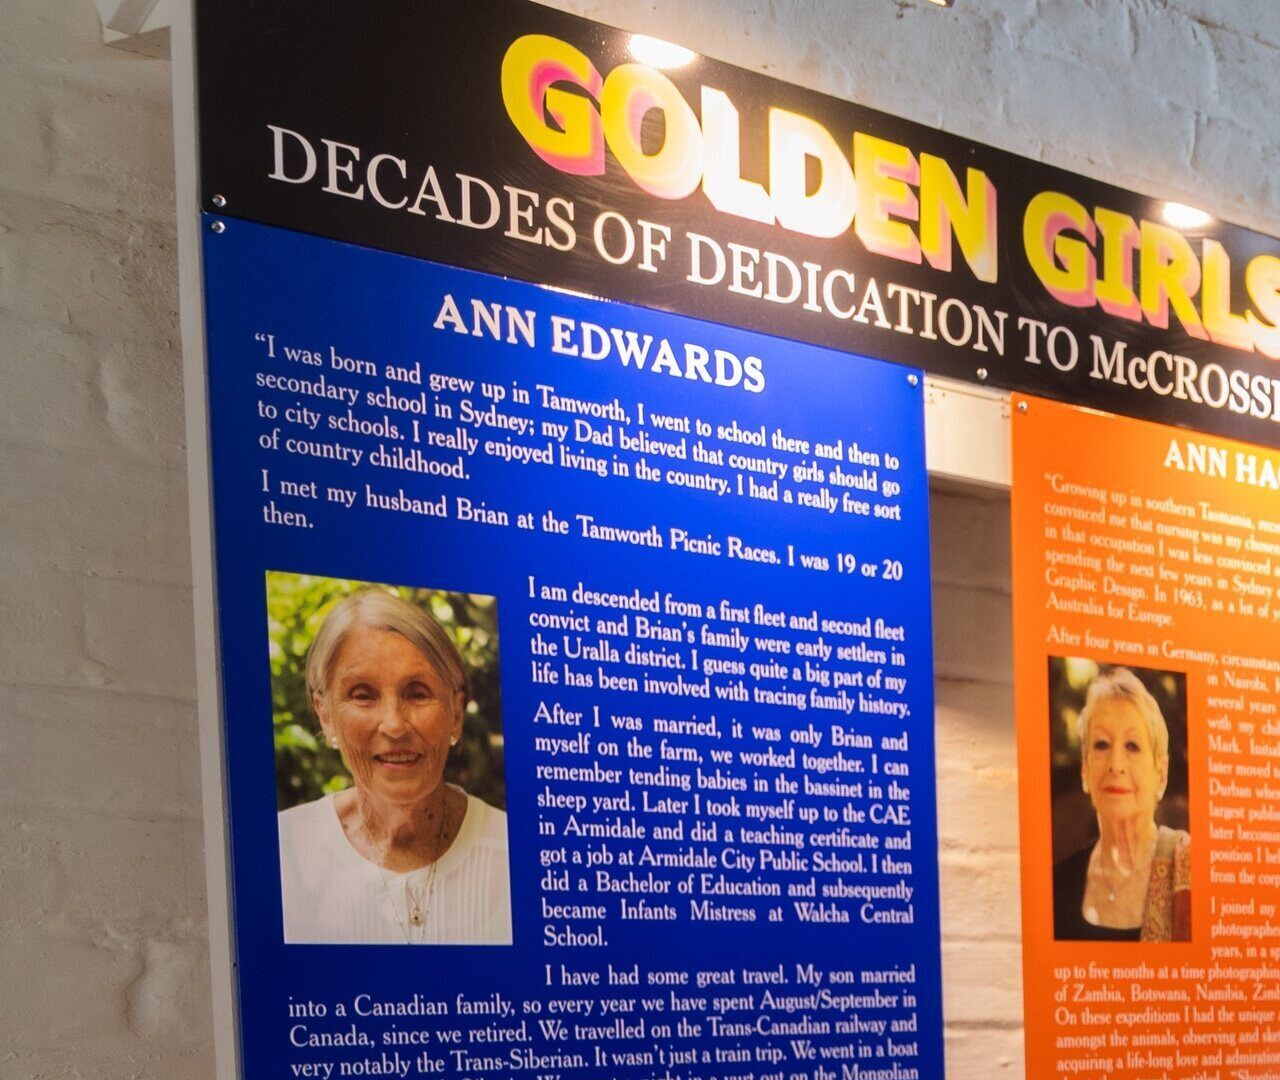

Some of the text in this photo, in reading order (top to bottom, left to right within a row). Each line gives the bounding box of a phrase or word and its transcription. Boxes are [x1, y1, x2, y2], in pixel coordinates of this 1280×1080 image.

[501, 34, 998, 284] GOLDEN
[267, 125, 577, 251] DECADES
[593, 211, 671, 272] OF
[686, 232, 1008, 356] DEDICATION
[1018, 317, 1079, 371] TO
[433, 294, 766, 393] ANN EDWARDS
[254, 332, 900, 470] “I was born and grew up in Tamworth, I went to school there and then to
[258, 427, 470, 479] of country childhood.
[1163, 439, 1229, 480] ANN
[528, 609, 906, 666] convict and Brian’s family were early settlers in
[540, 896, 914, 924] became Infants Mistress at Walcha Central
